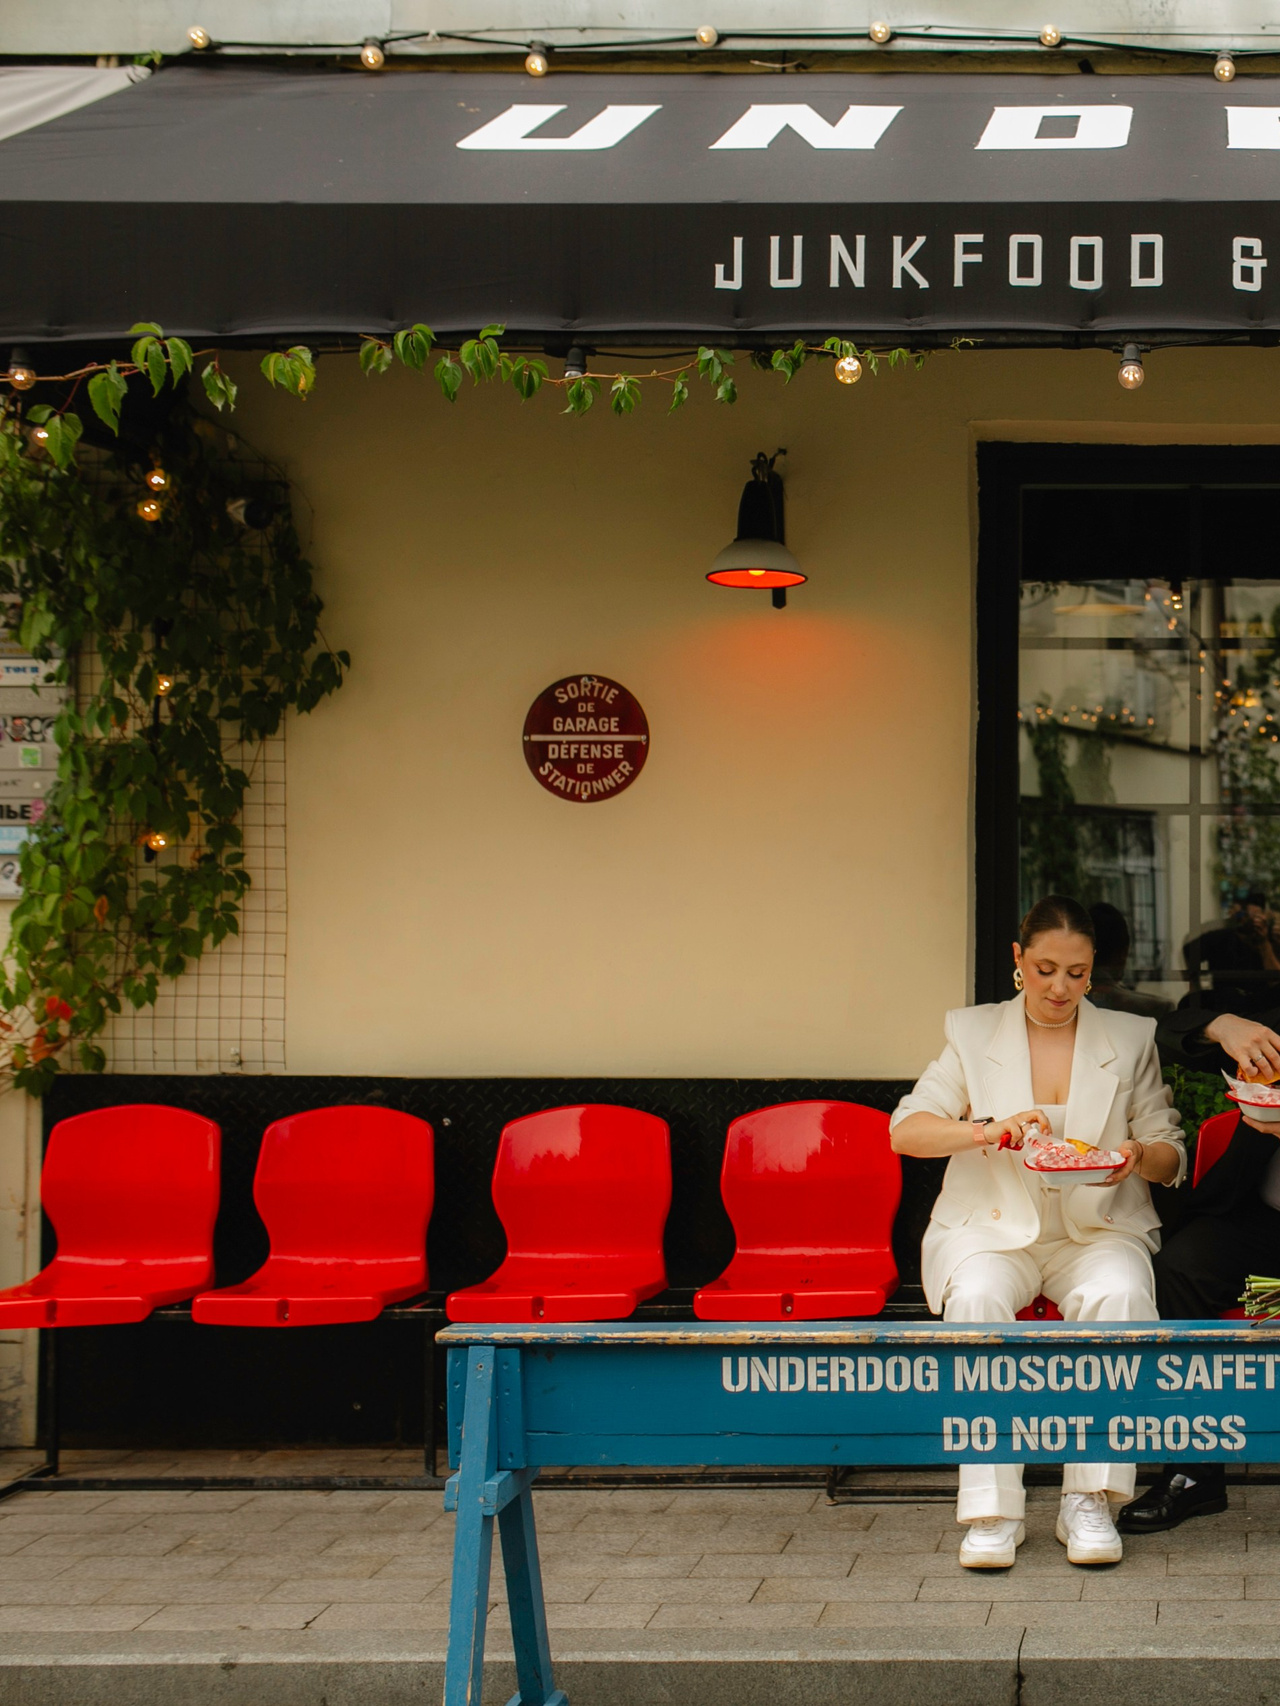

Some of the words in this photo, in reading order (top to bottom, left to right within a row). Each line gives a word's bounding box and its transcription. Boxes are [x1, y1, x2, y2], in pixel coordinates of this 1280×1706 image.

[714, 233, 1164, 290] JUNKFOOD
[1232, 236, 1268, 292] &
[555, 682, 620, 704] SORTIE
[578, 702, 595, 713] DE
[553, 717, 620, 732] GARAGE
[539, 760, 634, 795] STATIONNER
[577, 763, 594, 774] DE
[722, 1356, 939, 1393] UNDERDOG
[954, 1355, 1142, 1392] MOSCOW
[942, 1415, 997, 1452] DO
[1011, 1415, 1094, 1452] NOT
[1108, 1414, 1248, 1451] CROSS
